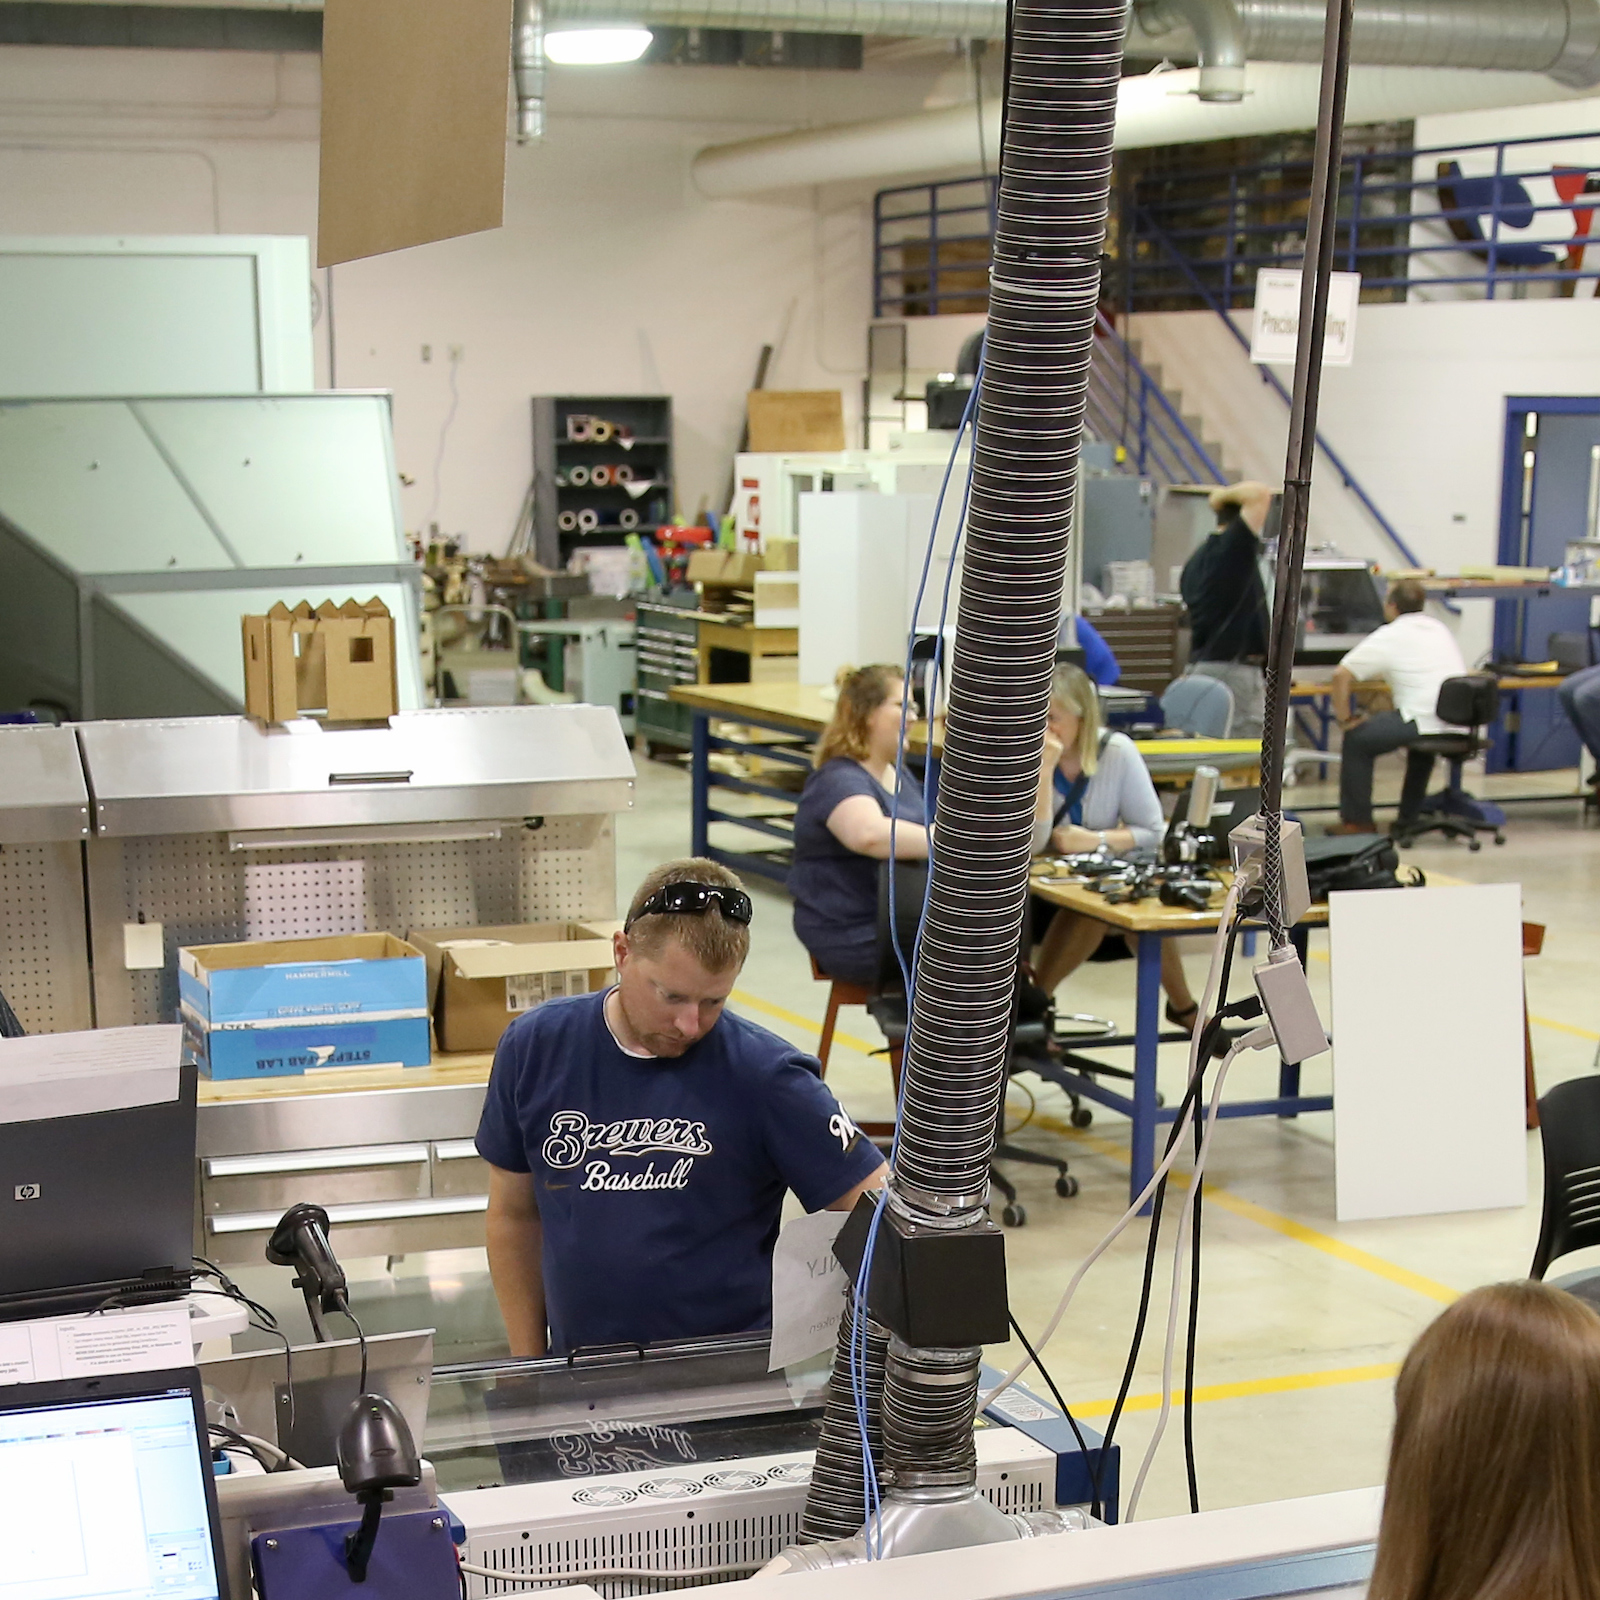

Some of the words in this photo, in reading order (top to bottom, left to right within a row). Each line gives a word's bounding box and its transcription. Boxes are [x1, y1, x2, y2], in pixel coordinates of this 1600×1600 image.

[285, 969, 351, 980] HAMMERMILL
[542, 1110, 713, 1169] Brewers
[580, 1157, 694, 1191] Baseball
